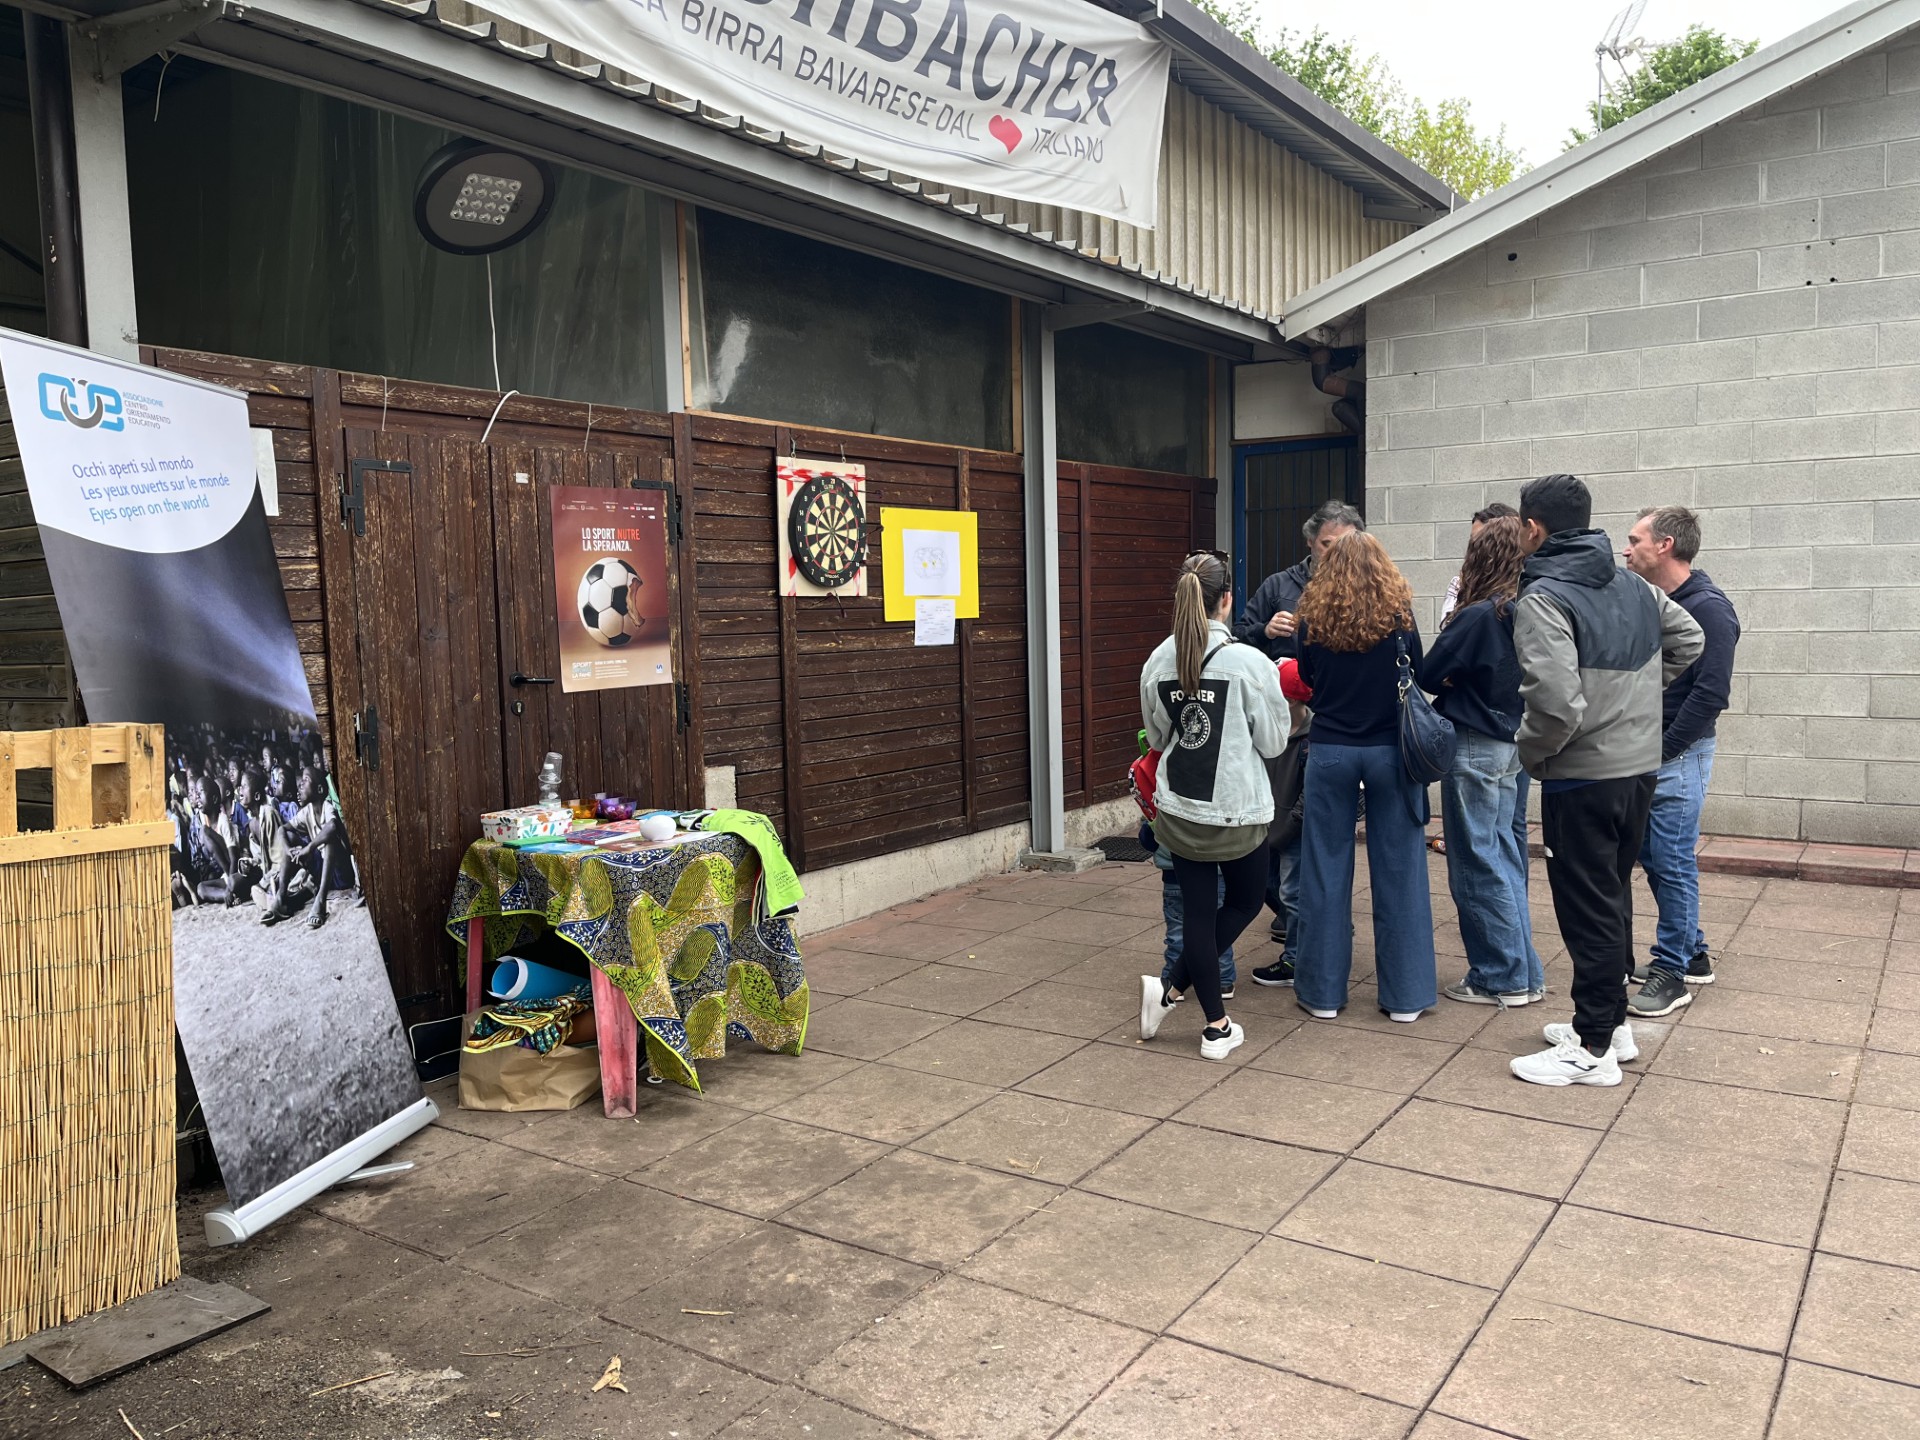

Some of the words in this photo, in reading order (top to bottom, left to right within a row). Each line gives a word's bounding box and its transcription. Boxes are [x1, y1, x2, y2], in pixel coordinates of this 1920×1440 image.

[681, 0, 784, 71] BIRRA
[794, 45, 937, 127] BAVARESE
[935, 103, 980, 142] DAL
[1028, 127, 1104, 164] ITALIANO
[122, 391, 164, 408] ASSOCIAZIONE
[124, 400, 149, 411] CENTRO
[126, 408, 171, 425] ORIENTAMENTO
[128, 416, 161, 430] EDUCATIVO
[72, 461, 107, 479] Occhi
[108, 459, 140, 479] aperti
[141, 457, 158, 473] sul
[158, 455, 194, 471] mondo
[80, 486, 103, 501] Les
[103, 484, 131, 502] yeux
[131, 479, 170, 496] ouverts
[170, 479, 186, 492] sur
[186, 475, 198, 489] le
[198, 472, 230, 488] monde
[89, 507, 118, 525] Eyes
[119, 504, 147, 522] open
[147, 501, 164, 515] on
[163, 498, 181, 513] the
[181, 494, 211, 511] world
[581, 527, 591, 540] LO
[592, 527, 615, 540] SPORT
[617, 528, 640, 540] NUTRE
[582, 540, 592, 551] LA
[593, 540, 633, 552] SPERANZA.
